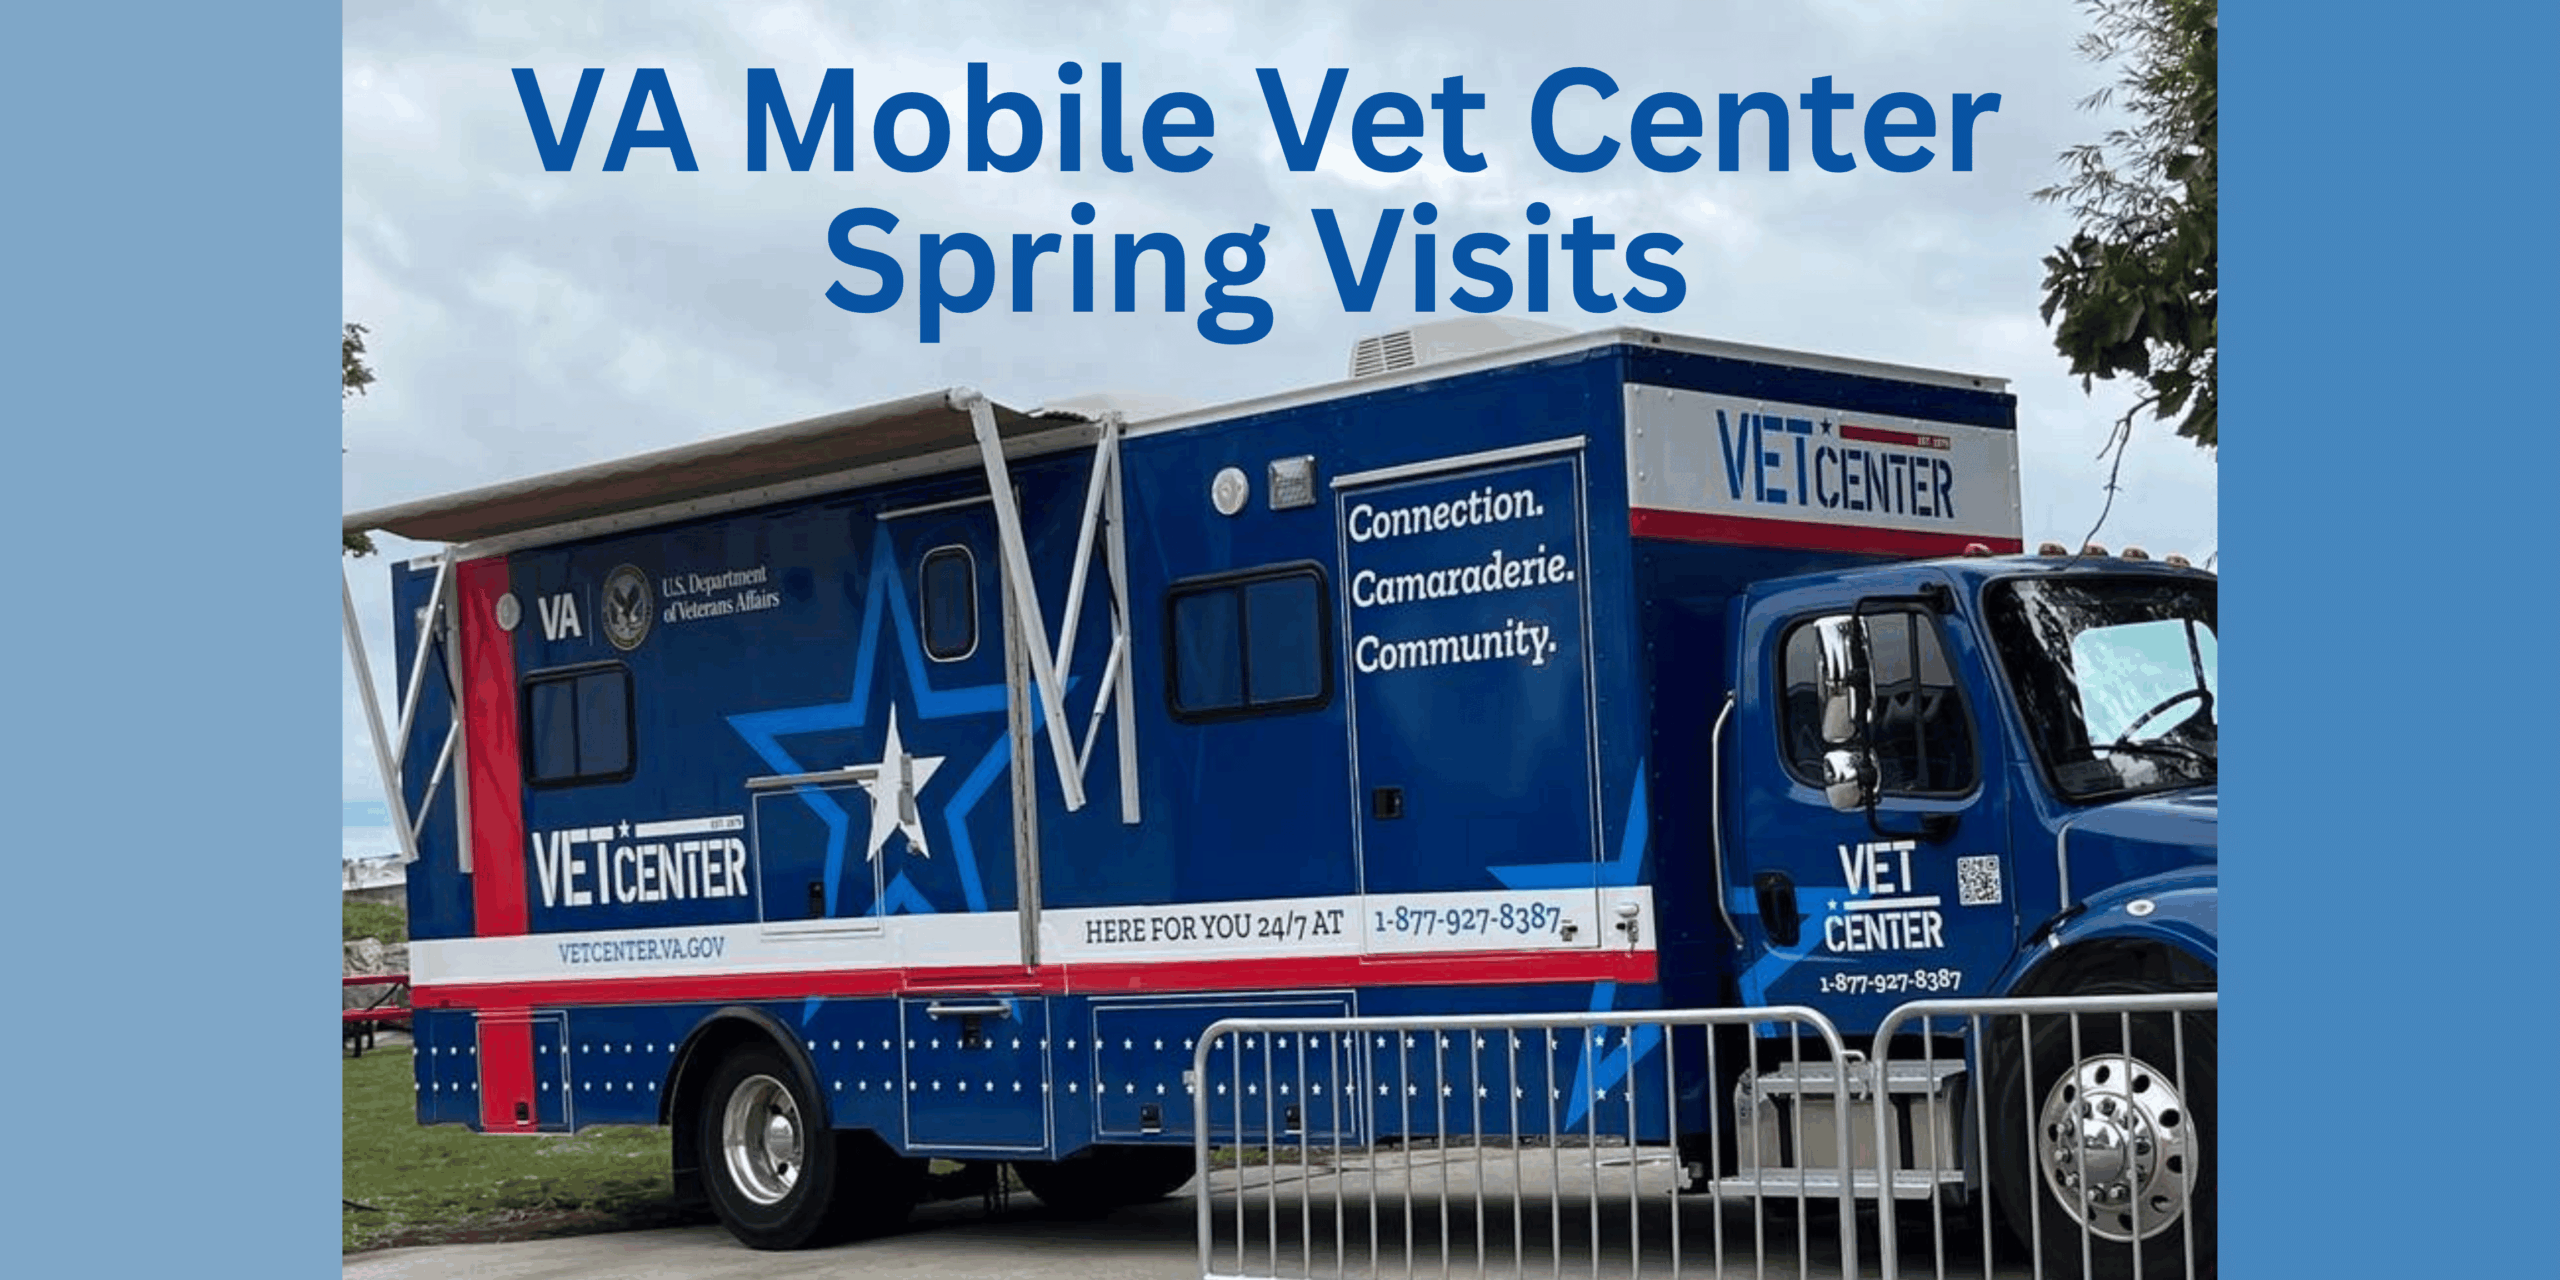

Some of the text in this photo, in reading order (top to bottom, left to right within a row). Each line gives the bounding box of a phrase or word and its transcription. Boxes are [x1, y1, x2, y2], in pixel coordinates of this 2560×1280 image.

[1716, 409, 1955, 519] VET CENTER
[1349, 486, 1544, 542] Connection.
[662, 565, 767, 598] U.S. Department
[1353, 544, 1575, 608] Camaraderie.
[537, 592, 583, 641] VA
[663, 589, 781, 623] of Veterans Affairs
[1355, 618, 1557, 673] Community.
[531, 826, 748, 908] VET CENTER
[1838, 840, 1916, 895] VET
[1085, 909, 1344, 944] HERE FOR YOU 24/7 AT
[1374, 902, 1562, 936] 1-877-927-8387
[1824, 910, 1945, 952] CENTER
[558, 936, 725, 964] VETCENTER.VA.GOV
[1819, 968, 1962, 995] 1-877-927-8387
